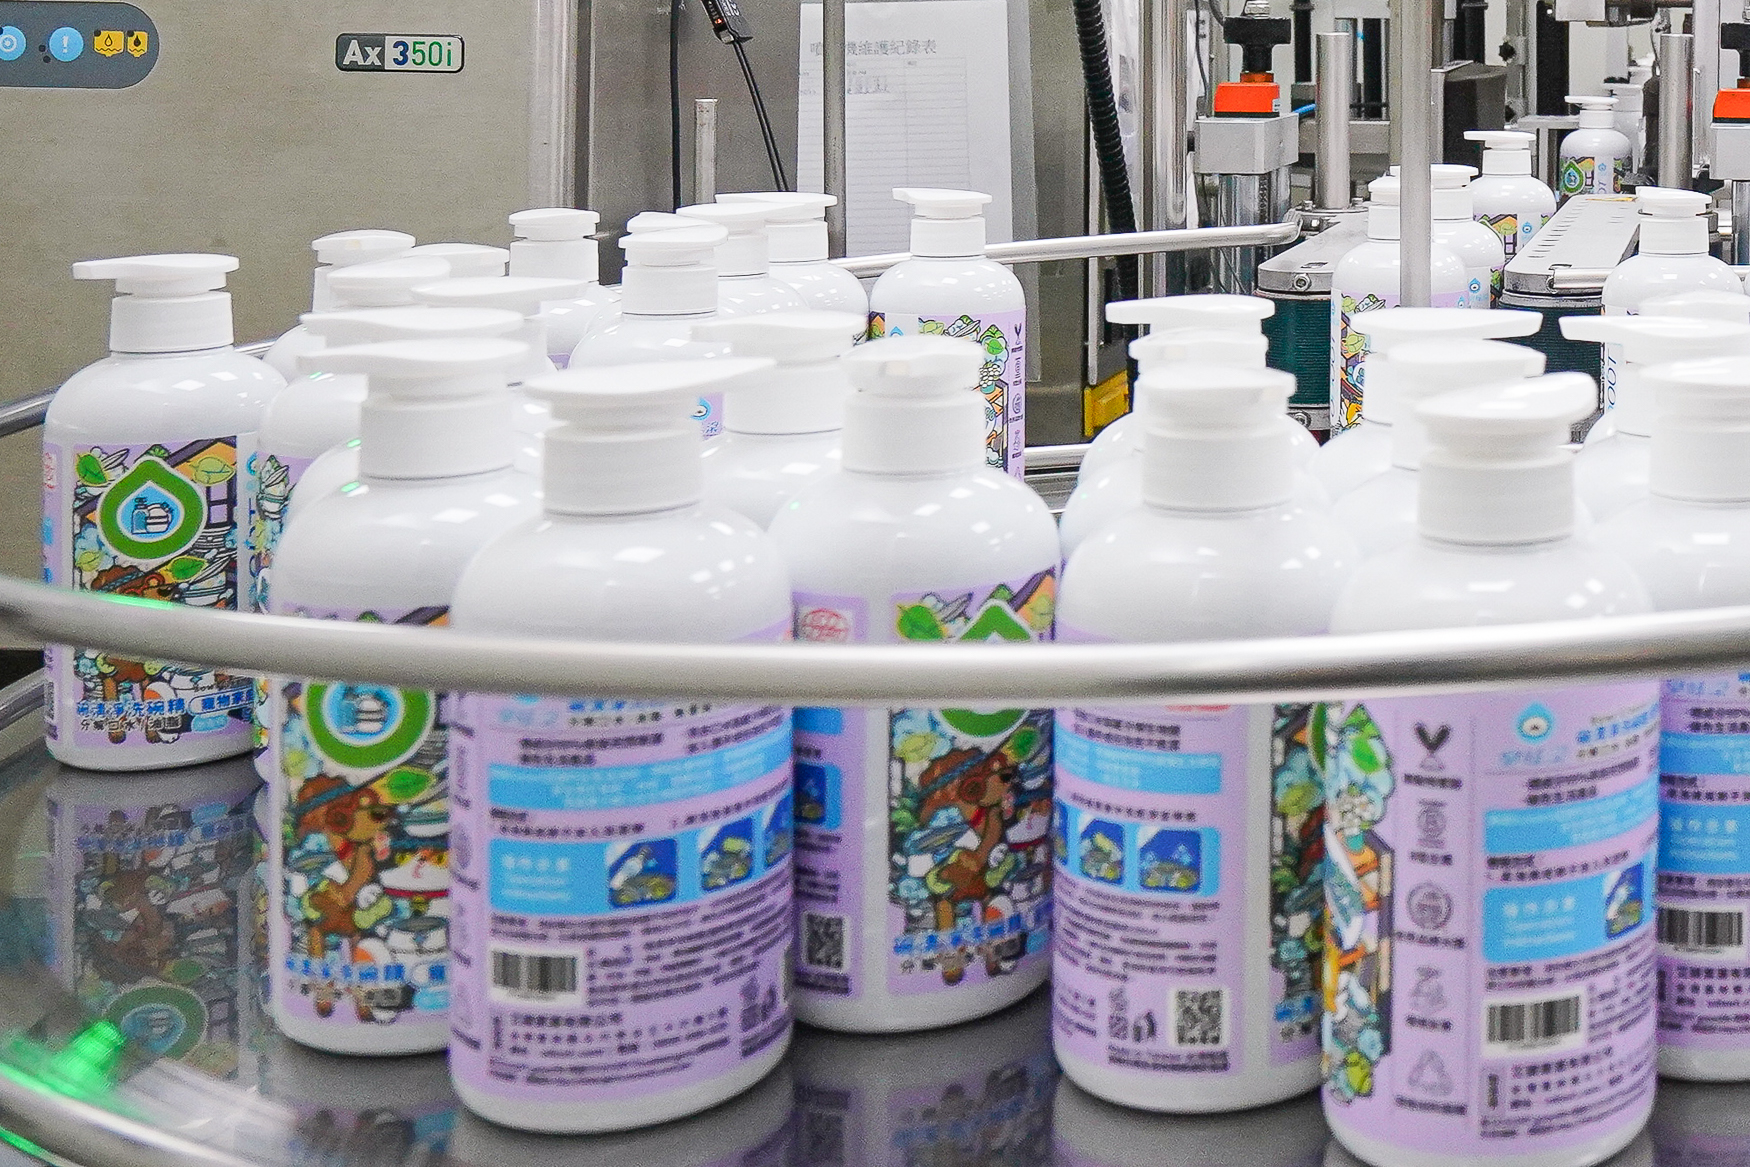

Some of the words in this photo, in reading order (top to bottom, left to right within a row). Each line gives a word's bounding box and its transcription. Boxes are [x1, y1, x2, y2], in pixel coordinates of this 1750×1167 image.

[810, 39, 937, 56] 噴機維護紀錄表
